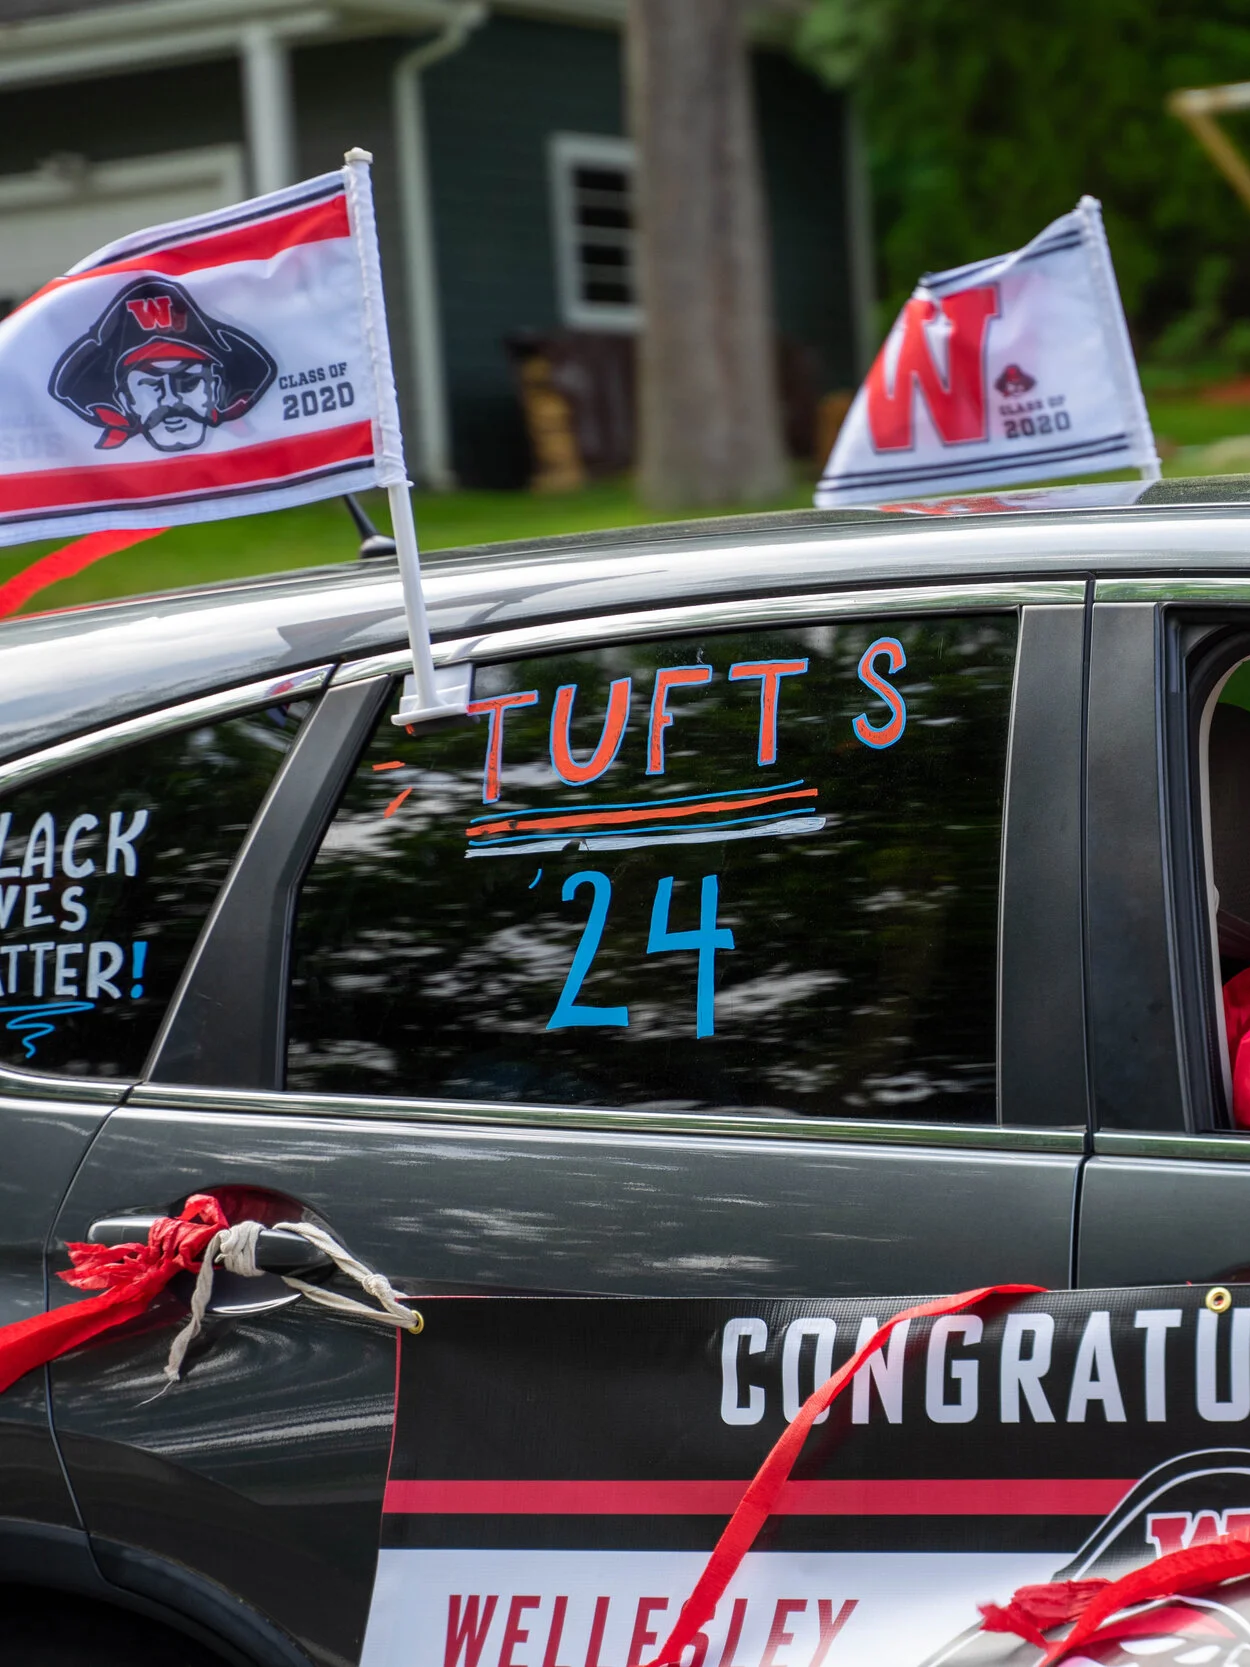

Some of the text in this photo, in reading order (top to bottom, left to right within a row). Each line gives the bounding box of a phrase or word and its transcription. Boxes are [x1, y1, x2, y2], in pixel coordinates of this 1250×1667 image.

[126, 295, 172, 331] W
[278, 362, 347, 390] CLASS OF
[282, 381, 354, 421] 2020
[999, 394, 1066, 416] CLASS OF
[1003, 410, 1070, 439] 2020
[465, 636, 907, 804] TUFTS
[0, 940, 148, 999] TTER!
